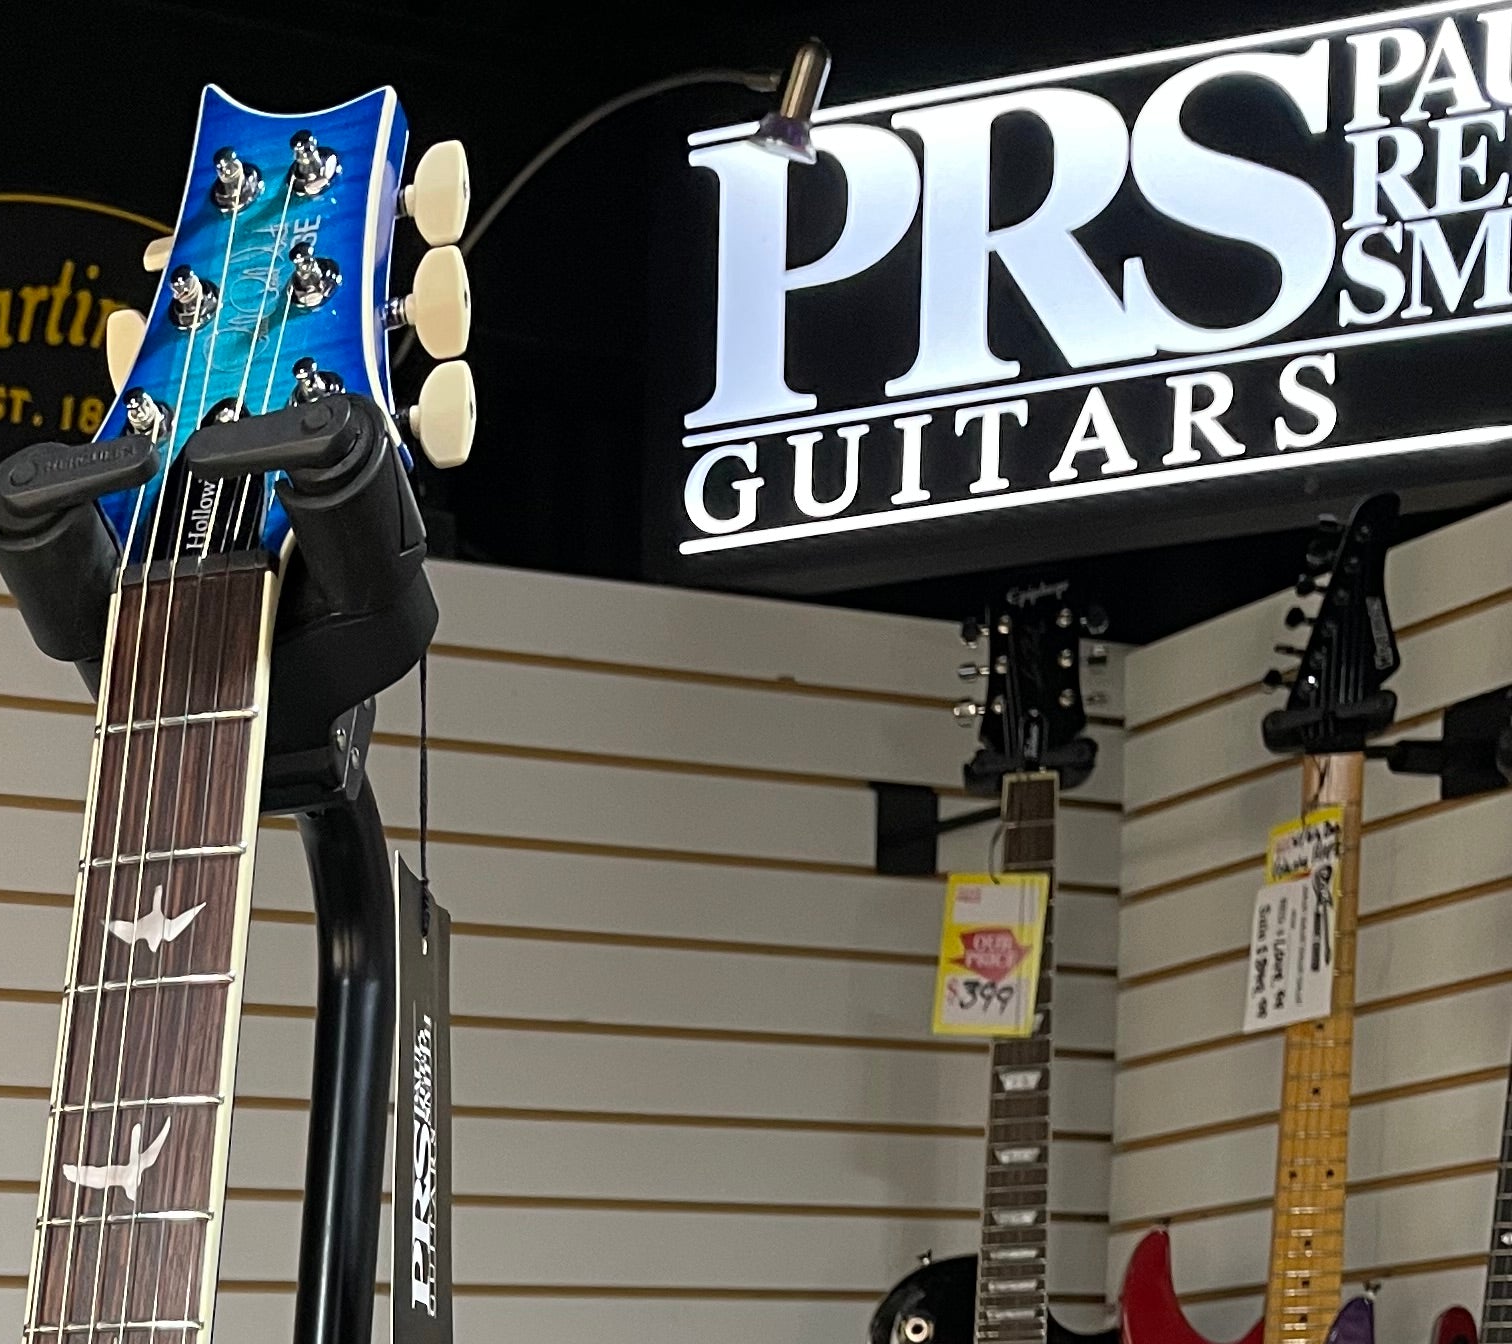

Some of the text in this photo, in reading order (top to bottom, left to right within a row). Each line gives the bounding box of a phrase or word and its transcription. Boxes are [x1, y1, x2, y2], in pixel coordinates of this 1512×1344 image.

[1342, 109, 1512, 231] RE
[684, 38, 1336, 430] PRS
[60, 394, 106, 435] 18
[683, 353, 1339, 535] GUITARS
[186, 479, 216, 550] Hollow
[973, 931, 1014, 951] OUR
[412, 1119, 431, 1310] PRS
